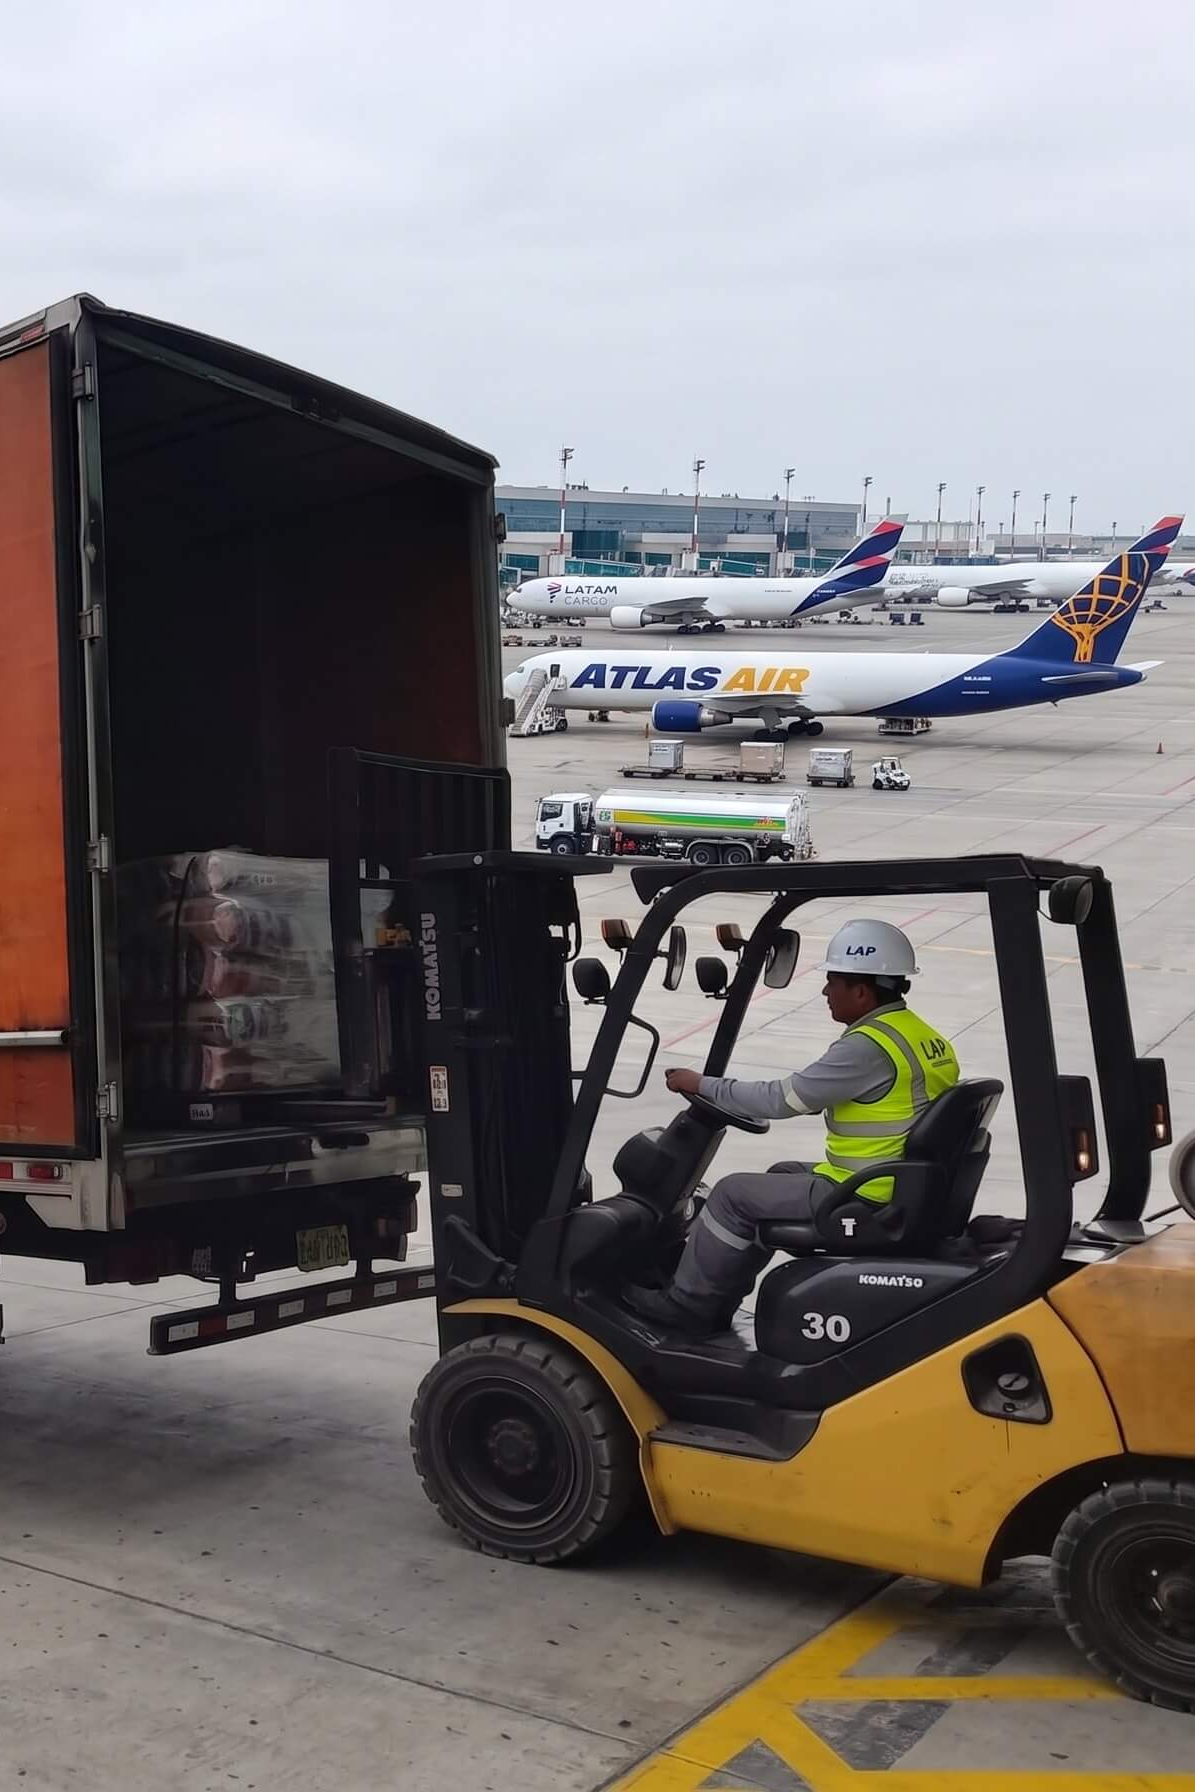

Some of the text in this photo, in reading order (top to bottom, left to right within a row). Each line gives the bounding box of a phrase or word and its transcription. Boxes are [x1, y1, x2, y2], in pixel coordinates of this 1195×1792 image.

[565, 585, 618, 595] LATAM
[565, 596, 608, 606] CARGO
[569, 663, 810, 692] ATLAS AIR
[846, 946, 877, 957] LAP
[418, 912, 442, 1021] KOMATSU
[920, 1038, 946, 1061] LAP
[801, 1312, 851, 1343] 30
